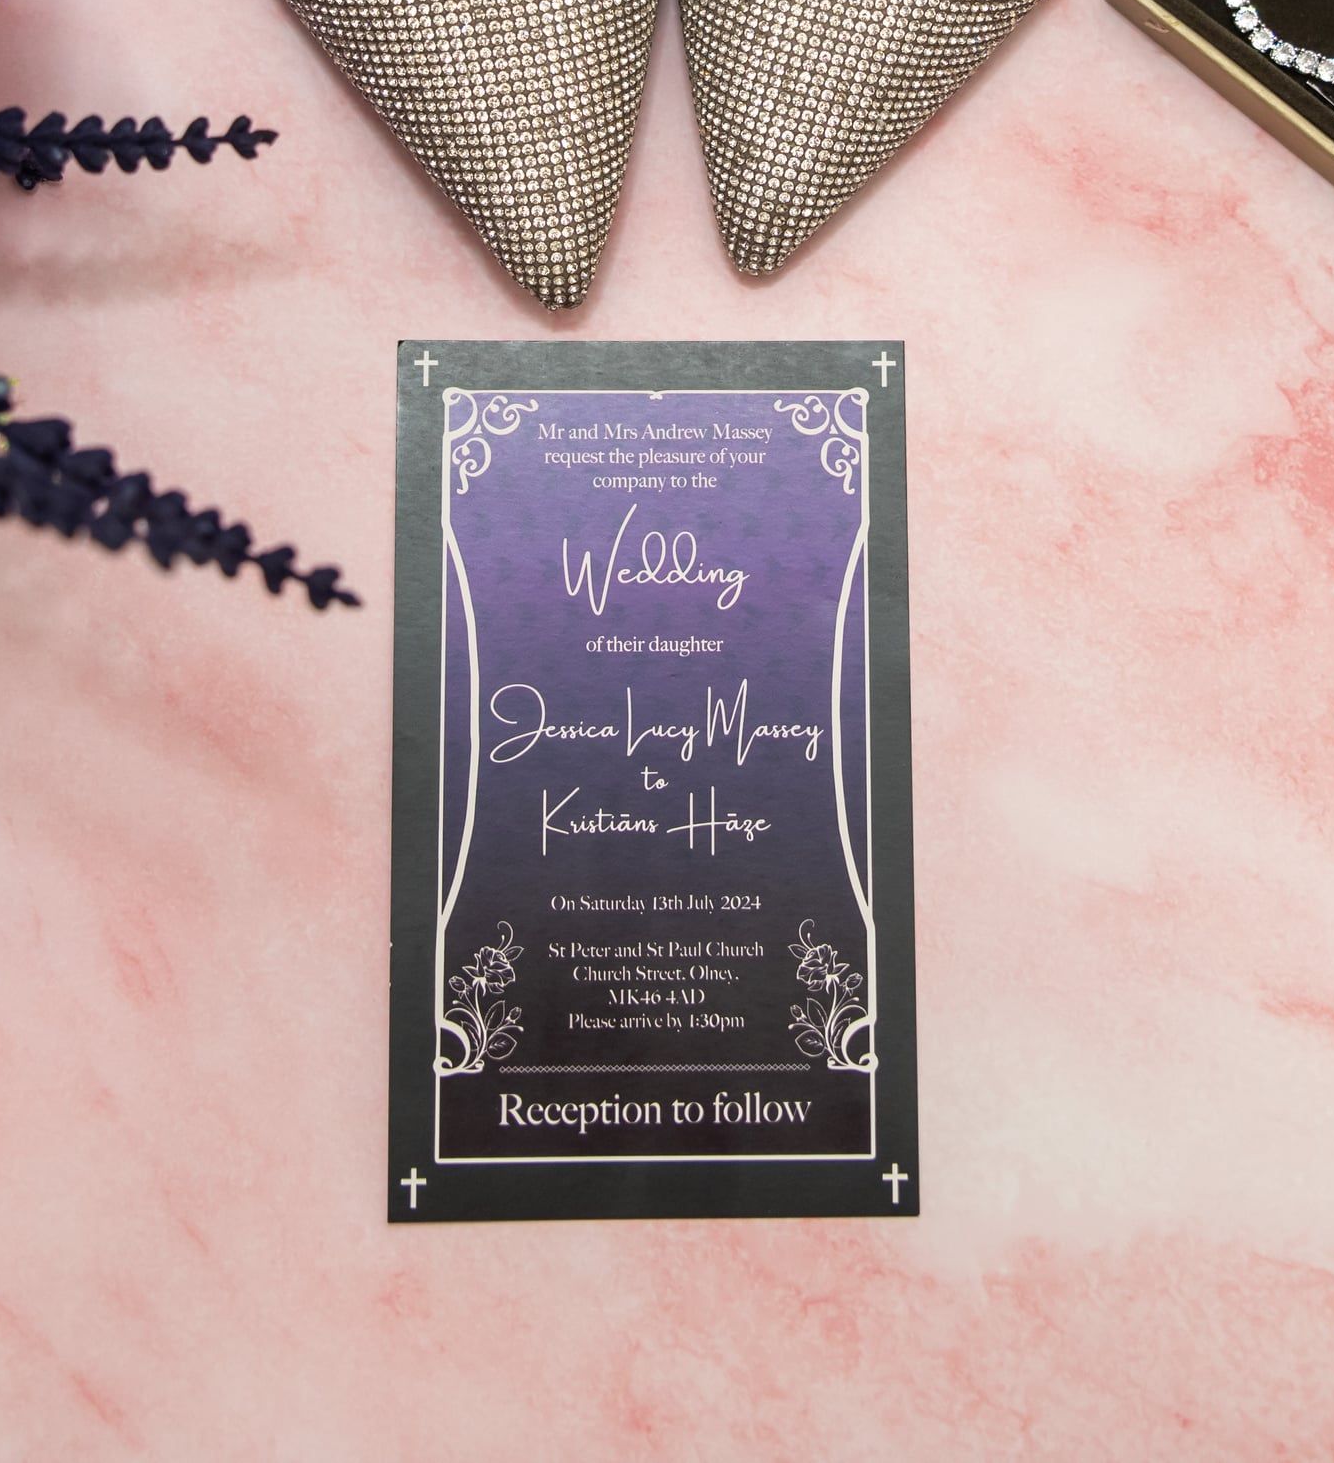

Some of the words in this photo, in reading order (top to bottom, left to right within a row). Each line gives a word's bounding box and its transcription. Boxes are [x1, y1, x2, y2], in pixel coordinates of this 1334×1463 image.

[537, 423, 565, 440] Mr
[568, 423, 599, 440] and
[603, 423, 638, 440] Mrs
[640, 423, 708, 440] Andrew
[712, 423, 773, 444] Massey
[544, 451, 606, 468] request
[608, 447, 635, 464] the
[638, 447, 706, 469] pleasure
[709, 447, 729, 464] of
[728, 452, 767, 469] your
[592, 476, 667, 493] company
[670, 475, 688, 488] to
[691, 471, 718, 489] the
[562, 503, 751, 616] Wedding
[585, 635, 605, 653] of
[605, 635, 646, 653] their
[648, 635, 724, 657] daughter
[489, 683, 620, 764] Jessica
[626, 686, 700, 762] Lucy
[706, 678, 825, 766] Massey
[640, 765, 669, 791] to
[550, 895, 575, 911] On
[579, 895, 645, 915] Saturday
[653, 894, 683, 911] 13th
[686, 894, 714, 915] July
[720, 895, 762, 910] 2024
[548, 942, 566, 958] St
[571, 942, 611, 958] Peter
[614, 941, 642, 958] and
[646, 942, 664, 957] St
[668, 941, 702, 958] Paul
[705, 941, 764, 957] Church
[572, 965, 631, 982] Church
[608, 988, 662, 1005] MK46
[665, 988, 705, 1005] 4AD
[569, 1013, 617, 1029] Please
[620, 1013, 663, 1029] arrive
[666, 1012, 682, 1033] by
[690, 1013, 745, 1033] 1:30pm
[499, 1093, 662, 1135] Reception
[671, 1099, 705, 1124] to
[712, 1091, 812, 1124] follow
